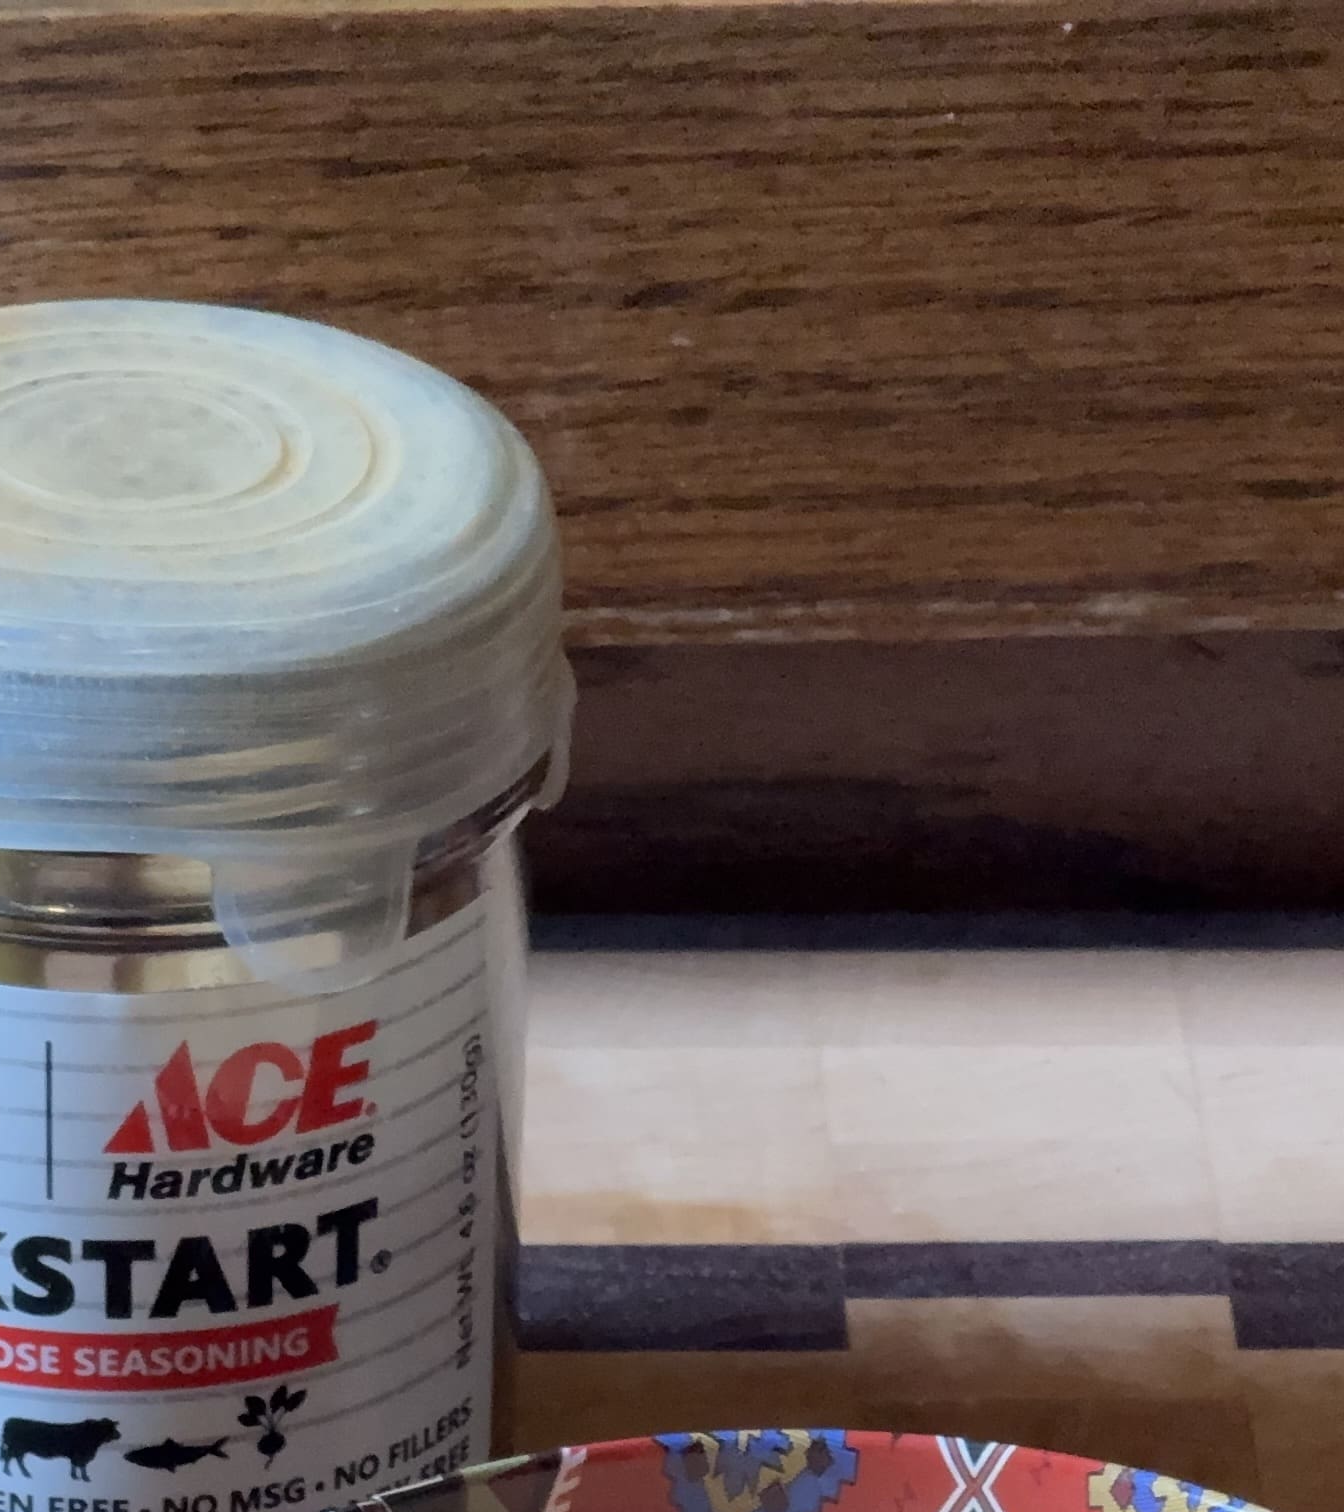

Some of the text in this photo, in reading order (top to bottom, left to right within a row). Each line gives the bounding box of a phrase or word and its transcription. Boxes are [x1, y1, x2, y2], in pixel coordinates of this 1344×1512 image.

[103, 1018, 379, 1154] ACE
[108, 1132, 376, 1200] Hardware
[74, 1327, 310, 1378] SEASONING
[334, 1453, 380, 1490] NO
[388, 1396, 473, 1469] FILLERS
